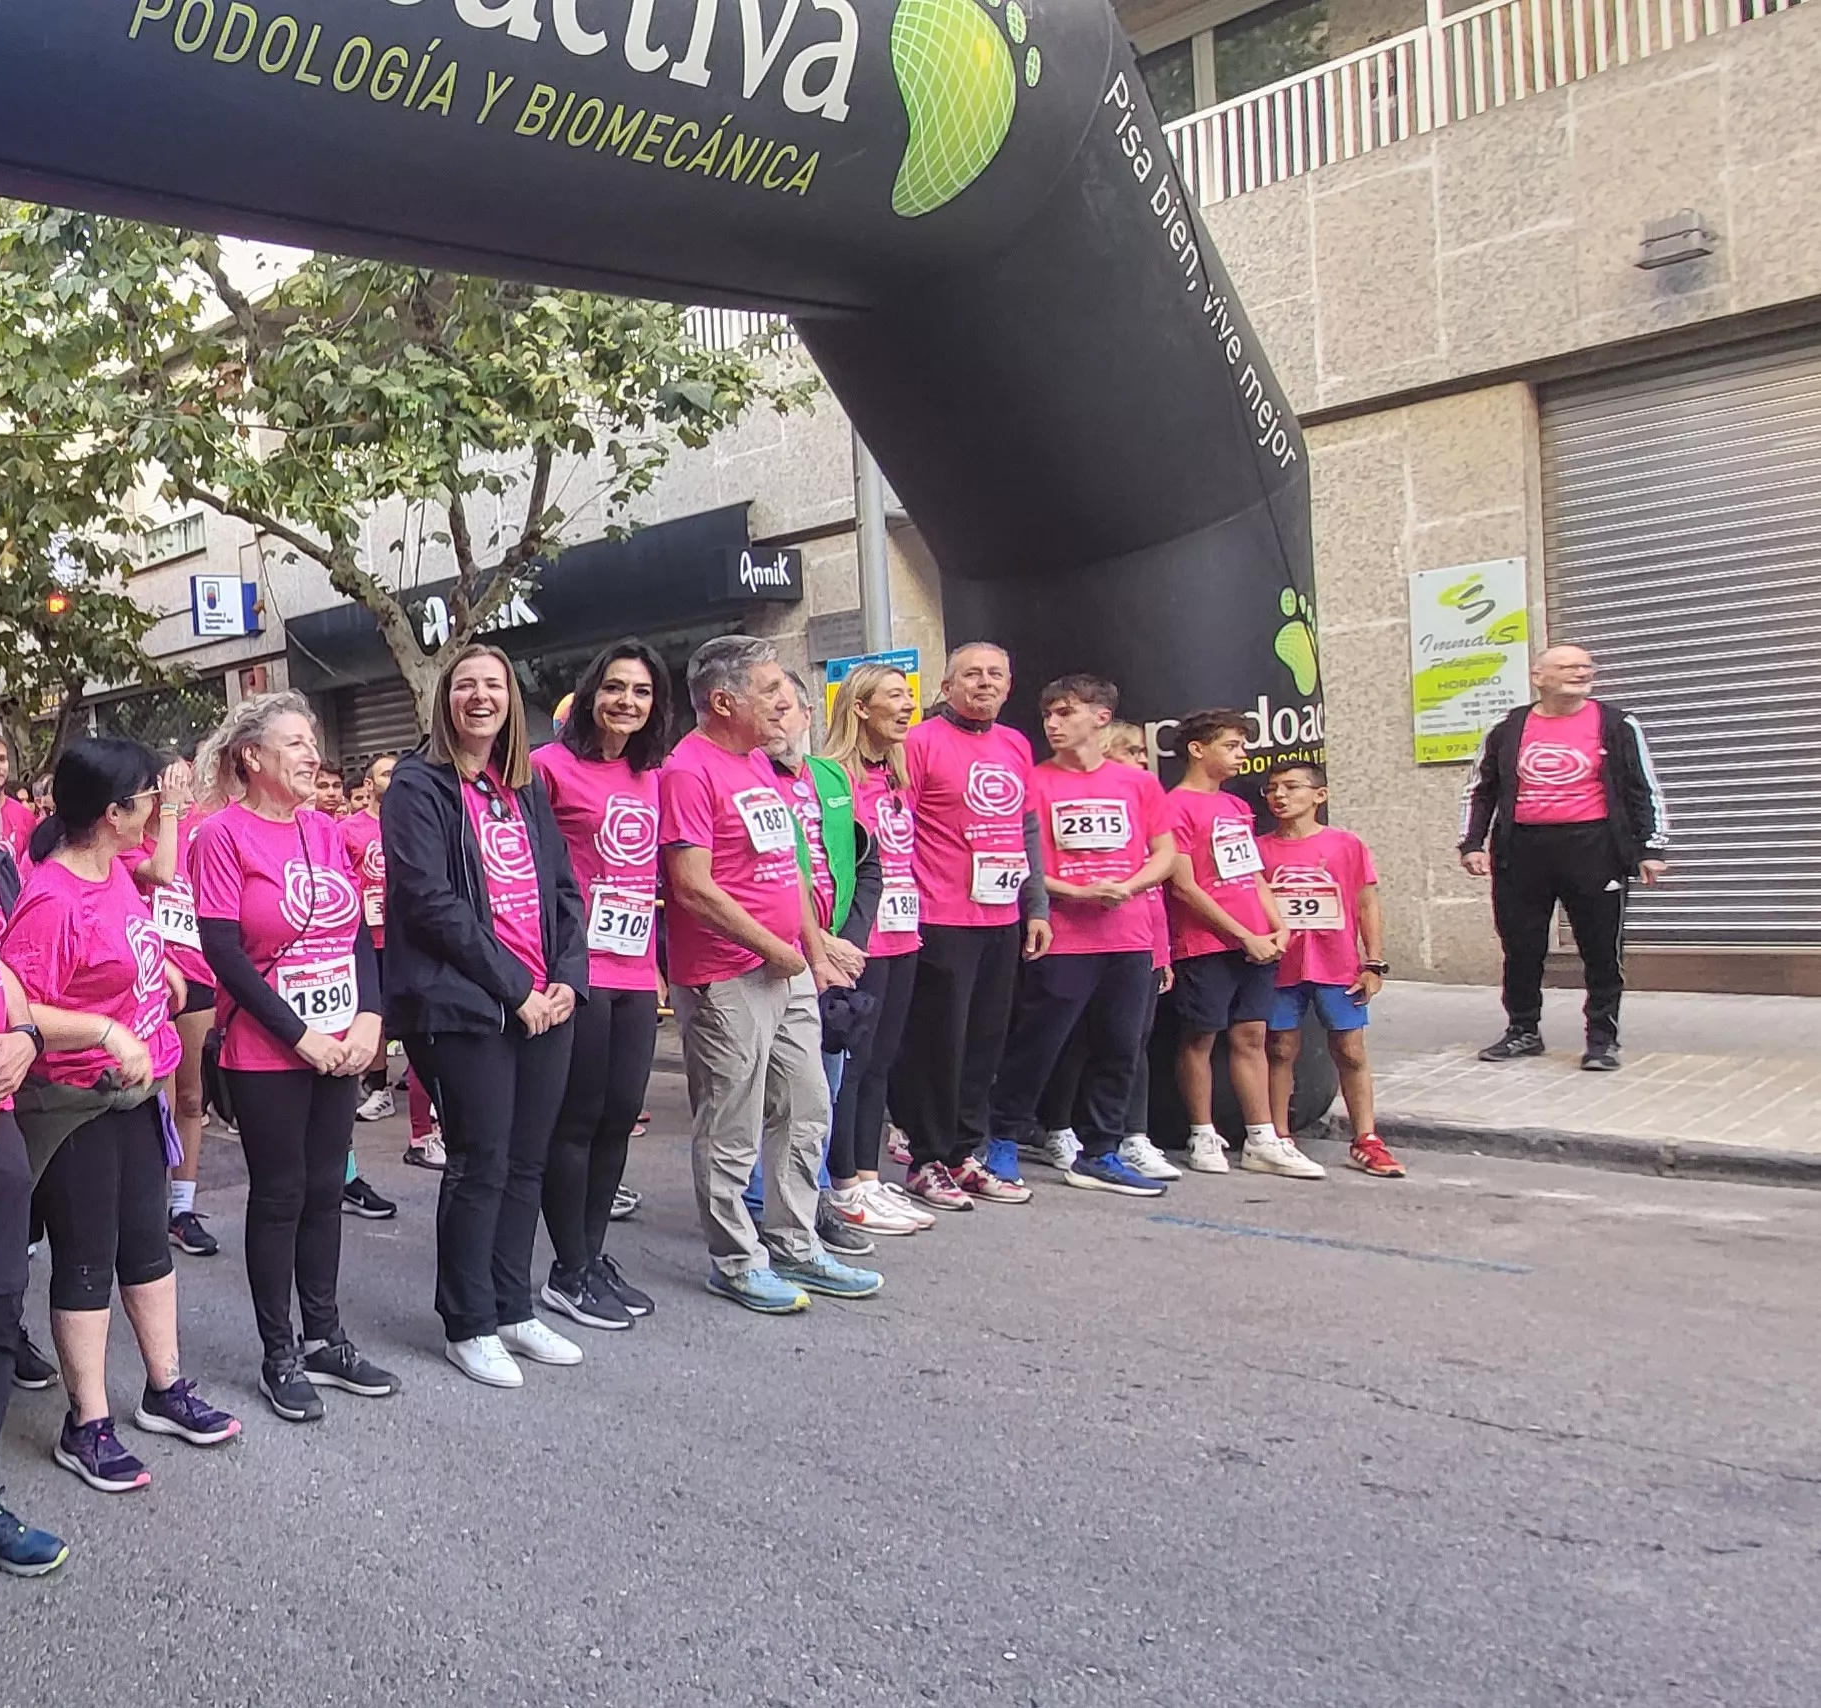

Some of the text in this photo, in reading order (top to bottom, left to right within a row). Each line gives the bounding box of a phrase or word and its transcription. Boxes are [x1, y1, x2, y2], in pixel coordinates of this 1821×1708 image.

[128, 0, 820, 197] PODOLOGÍA Y BIOMECÁNICA
[1104, 71, 1298, 468] Pisa bien, vive mejor
[752, 807, 787, 832] 1887
[1062, 817, 1122, 835] 2815
[1224, 843, 1251, 863] 212
[995, 871, 1021, 889] 46
[1287, 899, 1320, 916] 39
[161, 909, 199, 933] 178
[598, 909, 650, 938] 3109
[291, 982, 352, 1016] 1890
